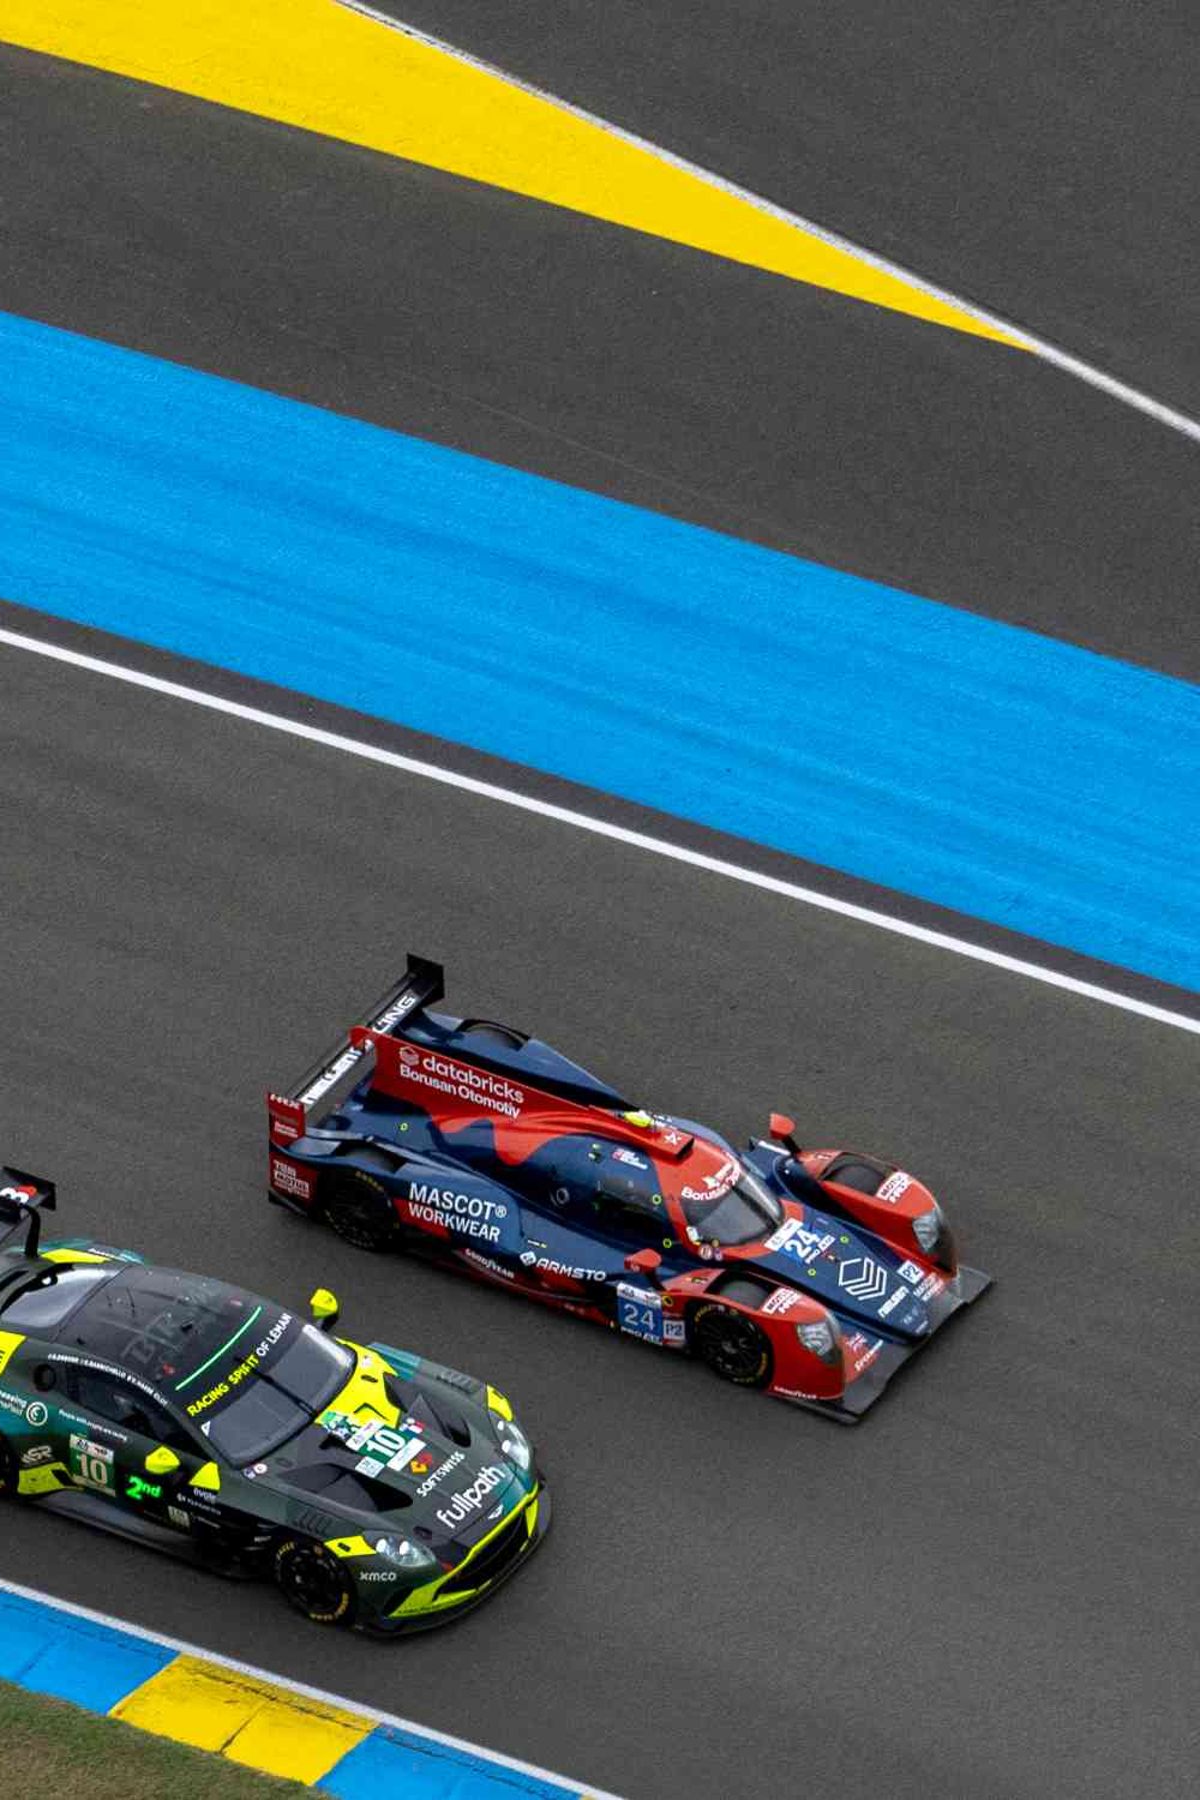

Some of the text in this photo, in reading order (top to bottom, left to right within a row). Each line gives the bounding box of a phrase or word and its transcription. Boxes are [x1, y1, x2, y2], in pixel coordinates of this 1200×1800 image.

[399, 1063, 522, 1120] Borusan Otomotiv
[422, 1055, 525, 1104] databricks
[407, 1201, 501, 1244] WORKWEAR
[784, 1229, 821, 1259] 24
[535, 1256, 608, 1282] ARMSTO
[623, 1302, 655, 1331] 24
[187, 1383, 230, 1417] RACING
[255, 1340, 271, 1357] OF
[265, 1312, 293, 1345] LEMAN
[366, 1428, 406, 1458] 10
[76, 1453, 108, 1485] 10
[416, 1451, 466, 1498] SOFTSWISS
[126, 1476, 162, 1500] 2nd
[436, 1466, 506, 1529] fullpath
[359, 1571, 398, 1582] xmco
